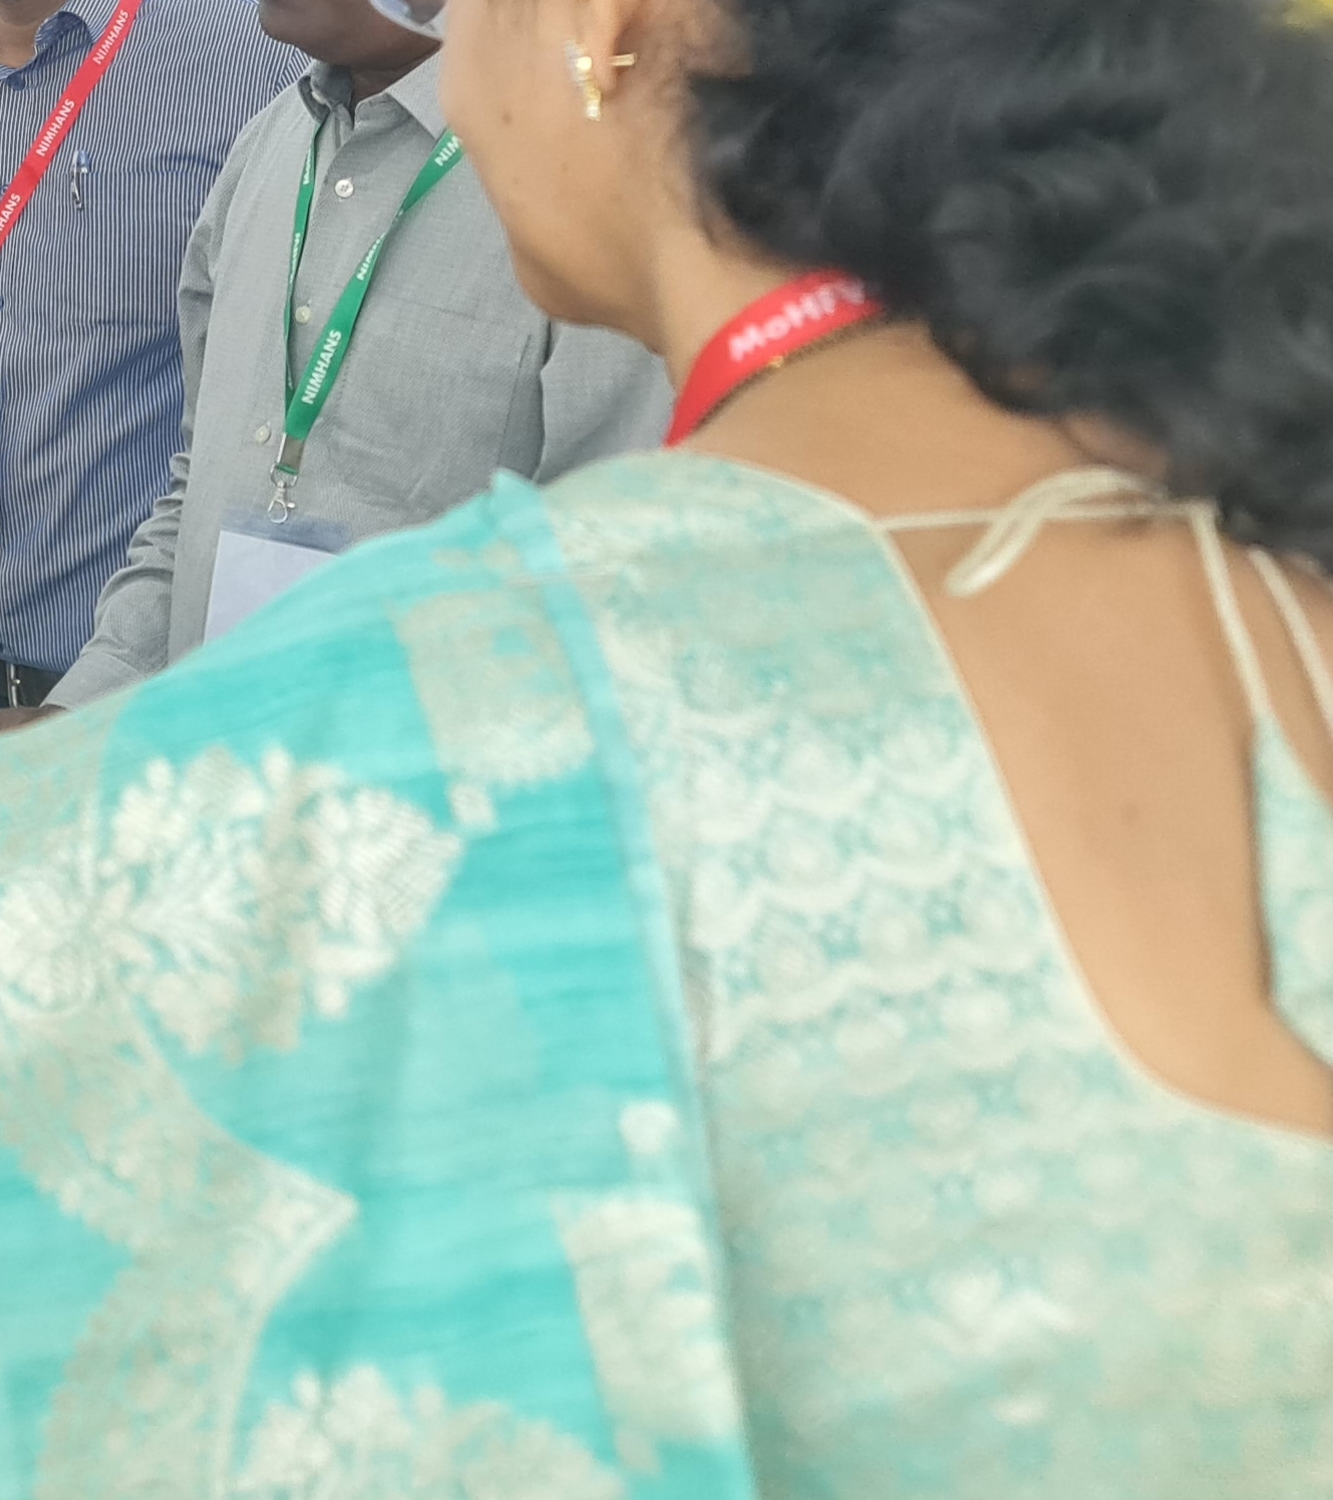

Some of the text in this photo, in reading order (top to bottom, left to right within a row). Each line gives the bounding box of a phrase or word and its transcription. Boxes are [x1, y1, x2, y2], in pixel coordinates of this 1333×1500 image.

[93, 8, 129, 65] NIMHANS
[37, 98, 75, 157] NIMHANS
[301, 329, 342, 405] NIMHANS
